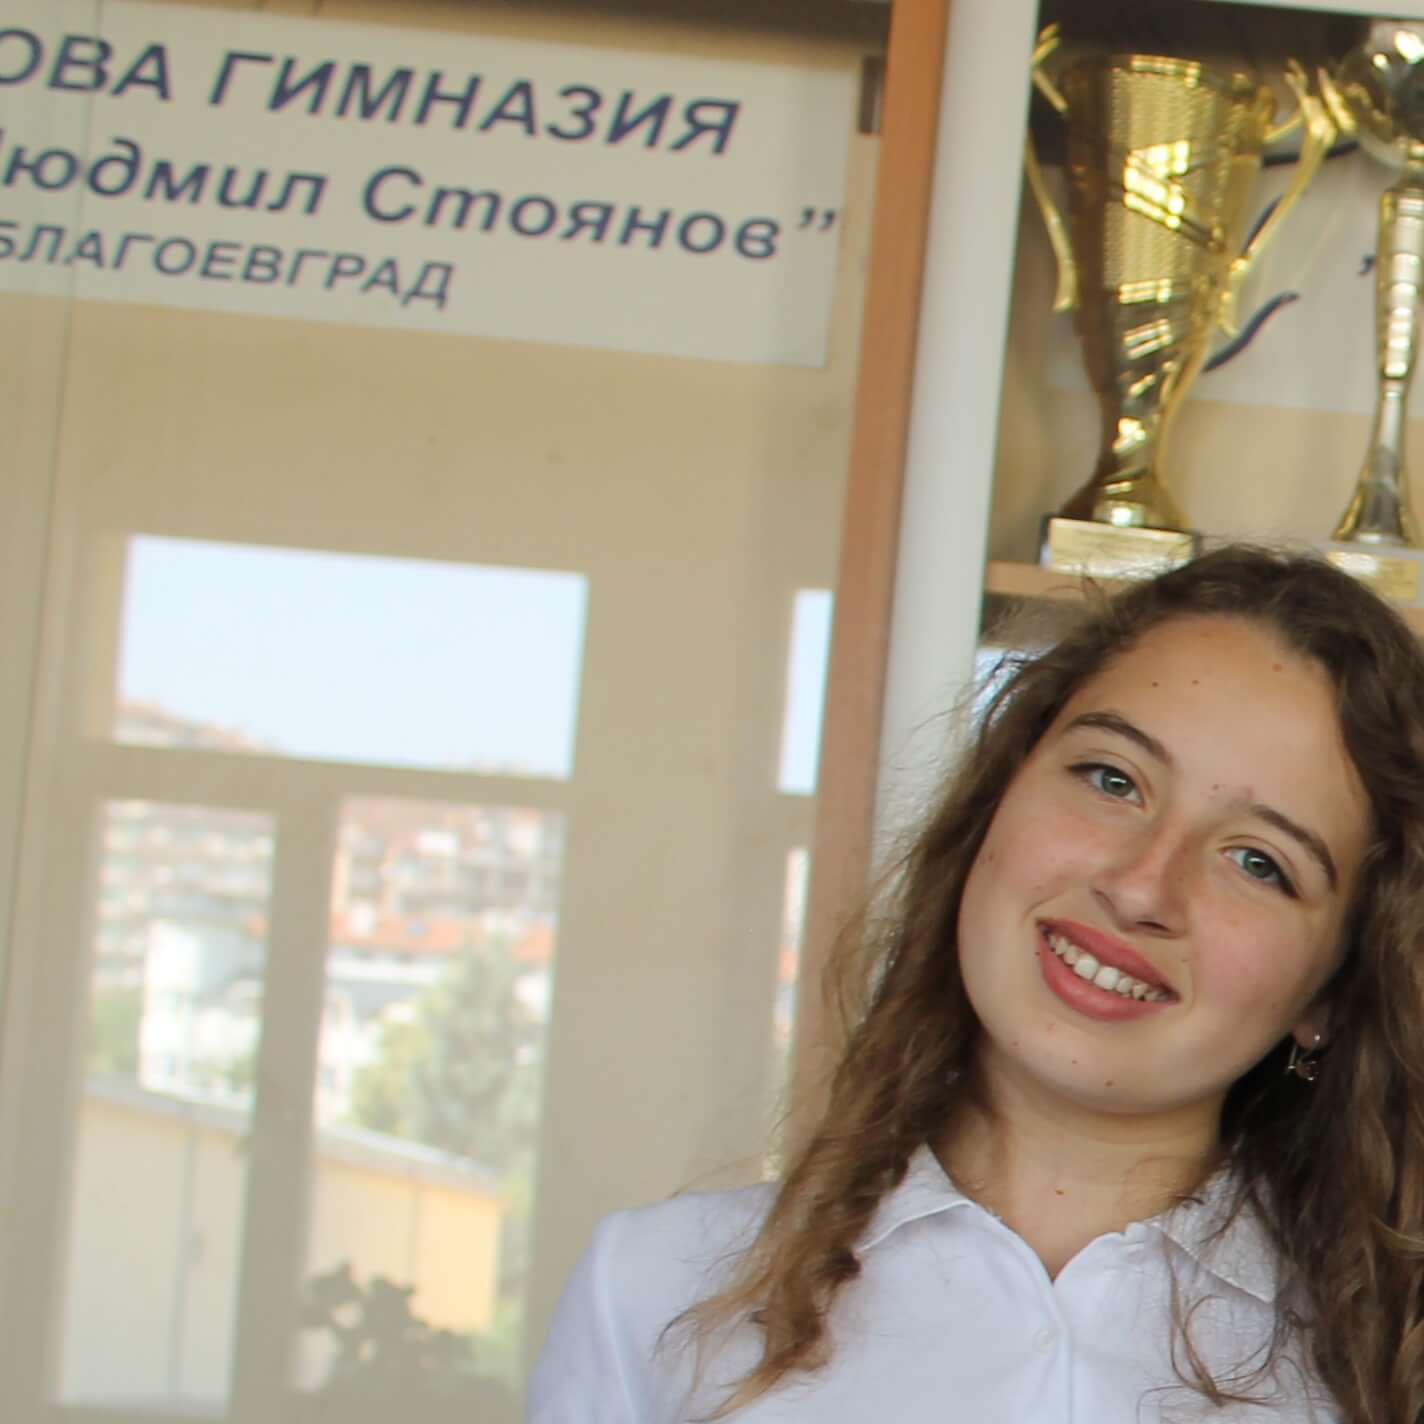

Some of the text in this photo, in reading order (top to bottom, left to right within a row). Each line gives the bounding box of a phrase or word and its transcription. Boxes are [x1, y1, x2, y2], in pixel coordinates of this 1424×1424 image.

[207, 50, 741, 156] ГИМНАЗИЯ
[0, 128, 328, 215] юдмил
[0, 220, 454, 309] БЛАГОЕВГРАД
